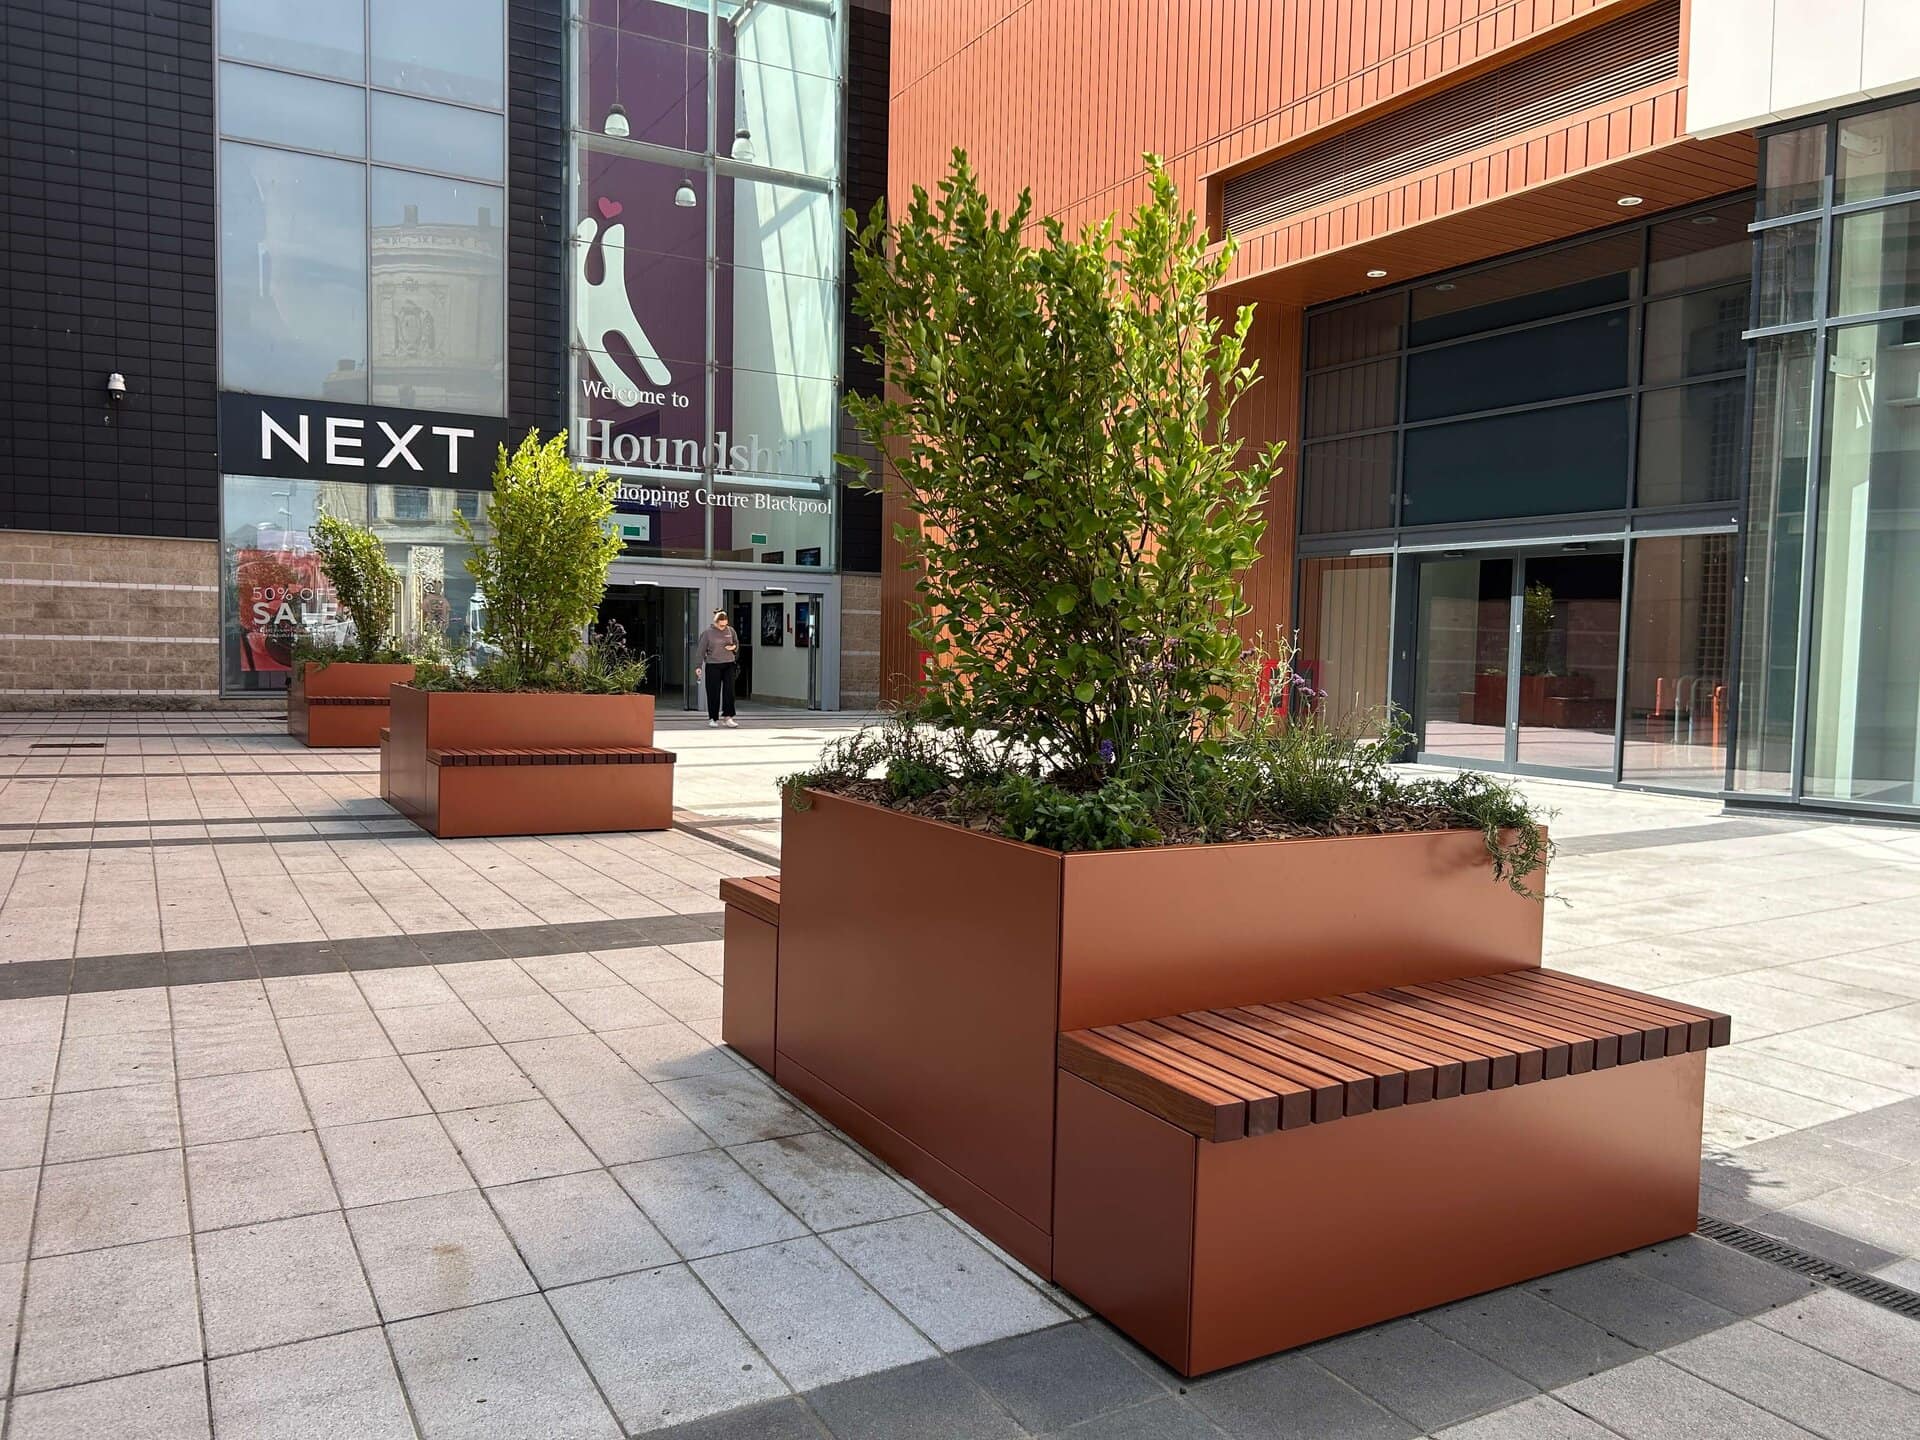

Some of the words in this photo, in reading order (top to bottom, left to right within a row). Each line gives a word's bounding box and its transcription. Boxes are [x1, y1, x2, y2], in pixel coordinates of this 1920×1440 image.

[581, 379, 665, 405] Welcome
[671, 391, 689, 408] to
[261, 410, 474, 473] NEXT
[694, 488, 749, 508] Centre
[755, 493, 832, 515] Blackpool
[252, 586, 293, 601] 50%
[252, 602, 338, 625] SALE
